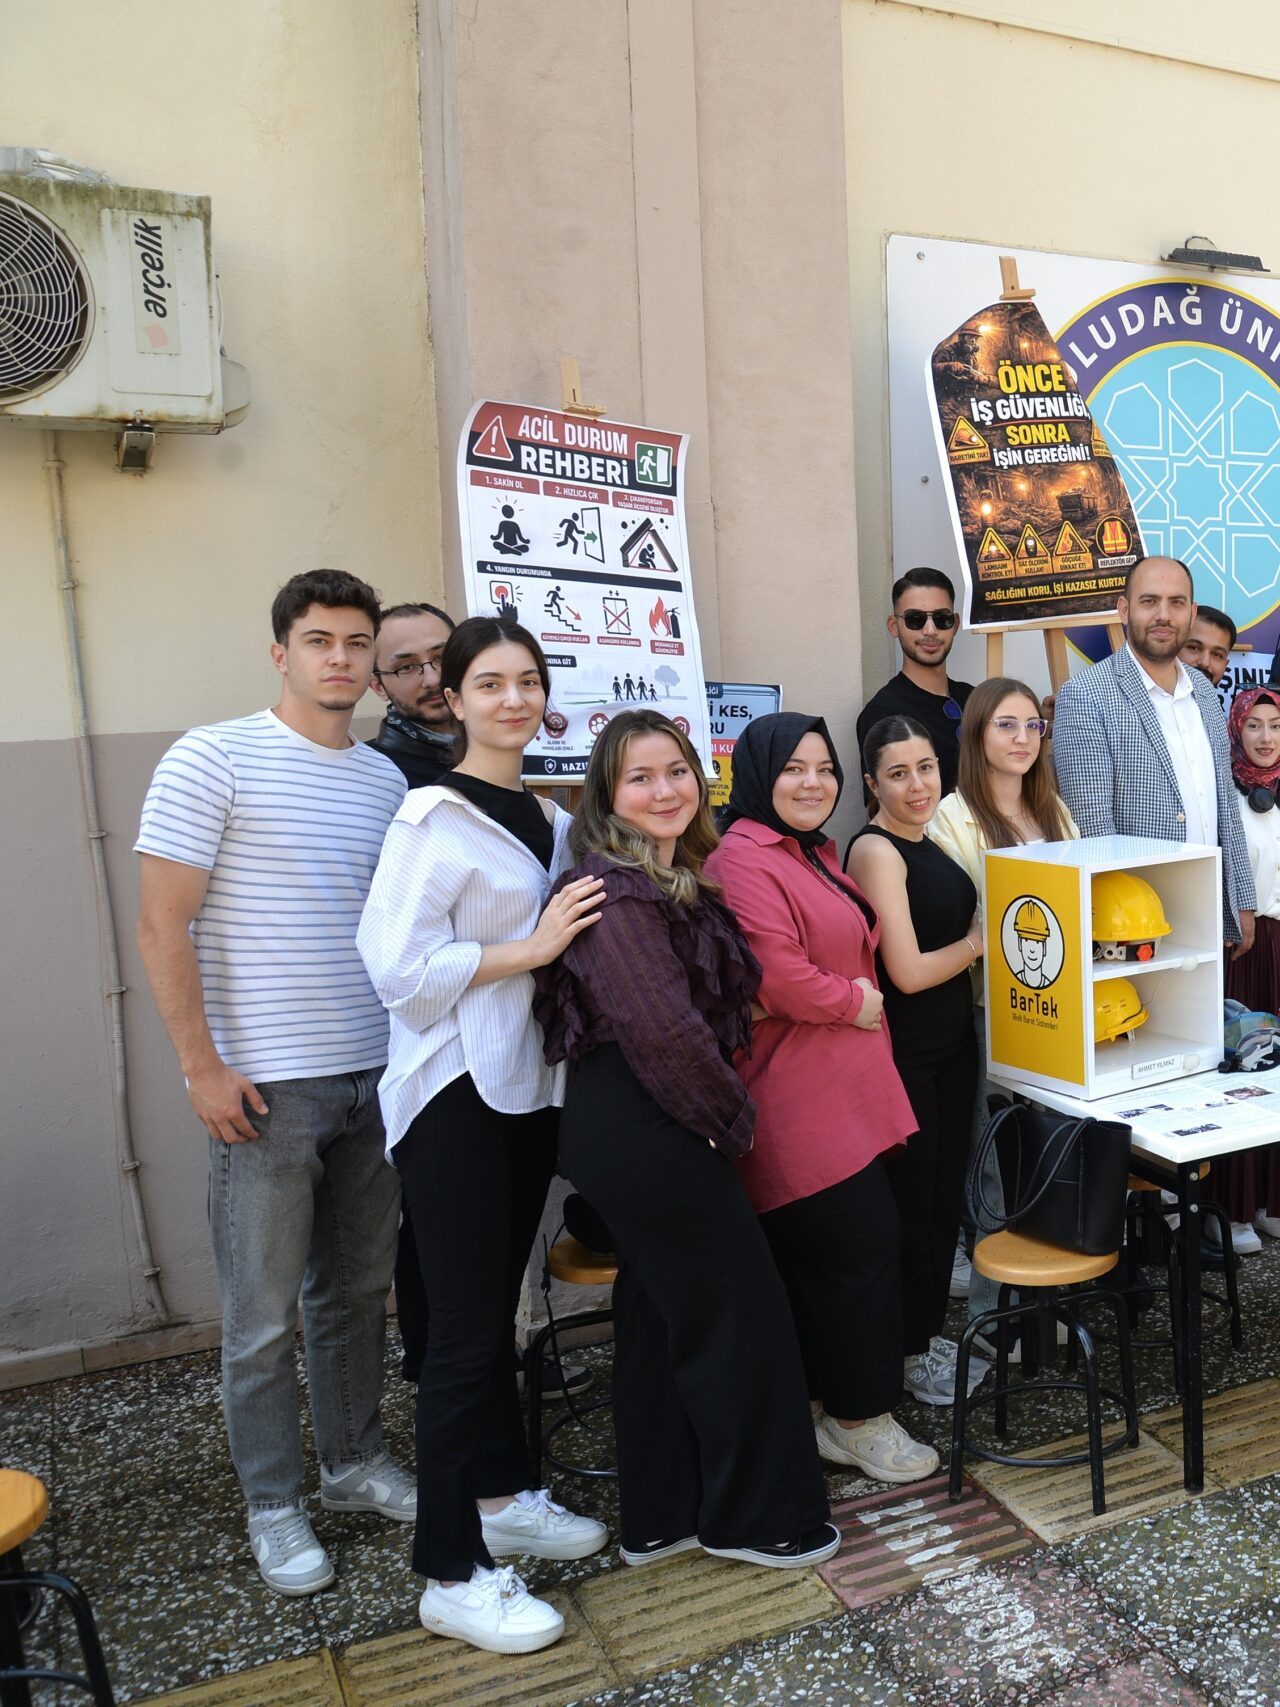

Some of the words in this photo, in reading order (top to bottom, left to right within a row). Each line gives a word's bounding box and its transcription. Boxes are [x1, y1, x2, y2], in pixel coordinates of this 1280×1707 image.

[133, 218, 172, 319] arçelik
[998, 359, 1066, 393] ÖNCE
[969, 398, 993, 426] İŞ
[996, 393, 1091, 420] GÜVENLİĞİ,
[518, 414, 559, 443] ACİL
[564, 423, 628, 456] DURUM
[1006, 423, 1070, 446] SONRA
[950, 453, 975, 462] BARETİNİ
[993, 445, 1023, 469] İŞİN
[1024, 443, 1091, 463] GEREĞİNİ!
[486, 476, 492, 485] 1.
[493, 477, 515, 489] SAKİN
[515, 481, 524, 489] OL
[554, 486, 562, 494] 2.
[563, 487, 587, 498] HIZLICA
[588, 491, 599, 500] ÇIK
[494, 565, 515, 574] YANGIN
[985, 588, 1026, 601] SAĞLIĞINI
[1028, 586, 1052, 597] KORU,
[1053, 583, 1064, 595] İŞİ
[1065, 580, 1097, 592] KAZASIZ
[544, 657, 561, 665] NINA
[562, 657, 572, 665] GİT
[719, 705, 752, 720] KES,
[1010, 987, 1058, 1019] BarTek
[1138, 1063, 1155, 1072] AHMET
[1156, 1058, 1175, 1068] YILMAZ
